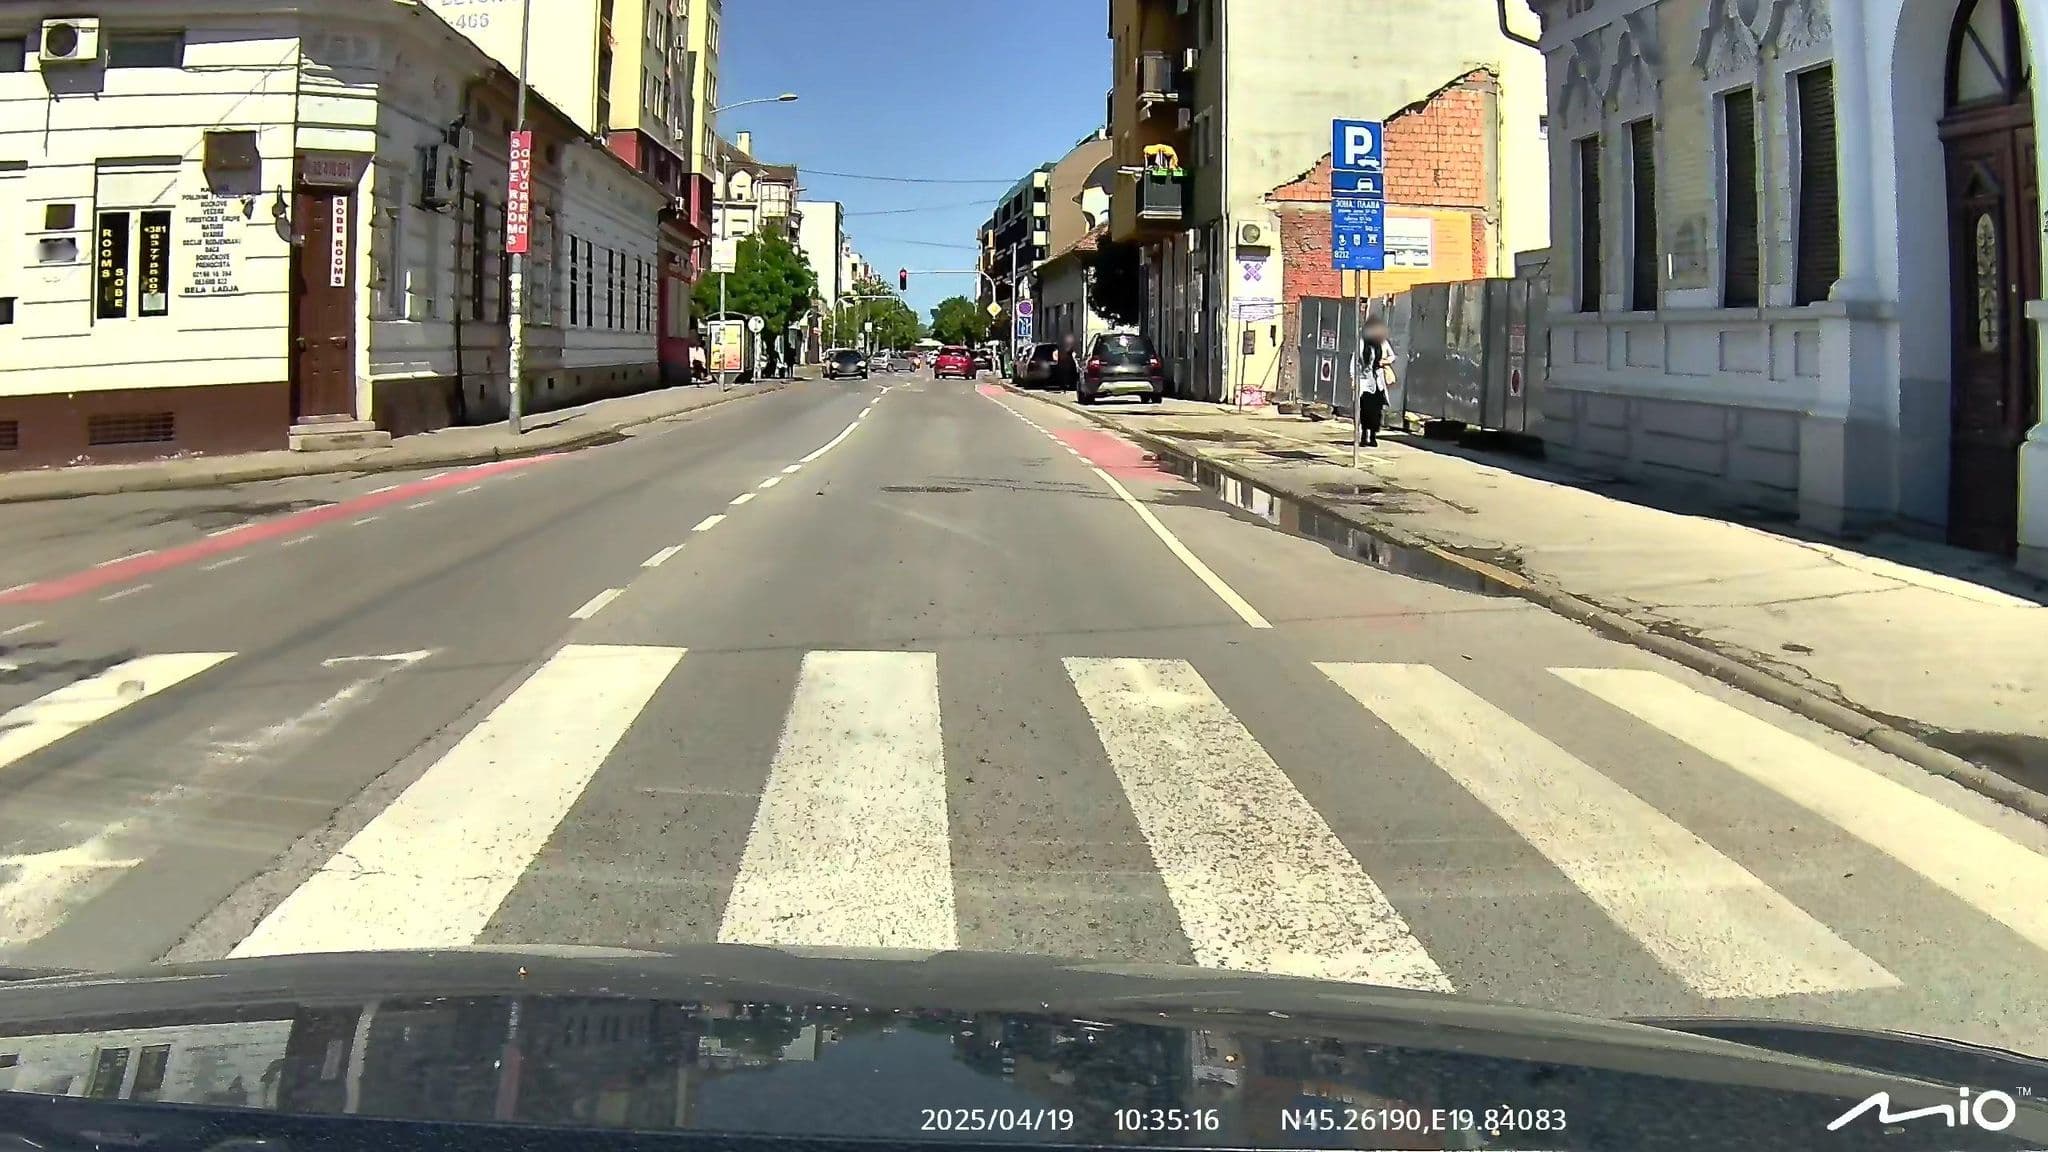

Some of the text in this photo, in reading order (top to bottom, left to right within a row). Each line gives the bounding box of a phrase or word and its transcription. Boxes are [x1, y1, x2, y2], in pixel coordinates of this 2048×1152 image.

[1345, 126, 1373, 164] P
[507, 138, 520, 245] SOBE ROOMS
[518, 148, 530, 233] OTVORENO
[101, 229, 112, 278] ROOMS
[334, 199, 344, 284] SOBE ROOMS
[1334, 250, 1349, 259] 8212
[114, 268, 124, 307] SOBE
